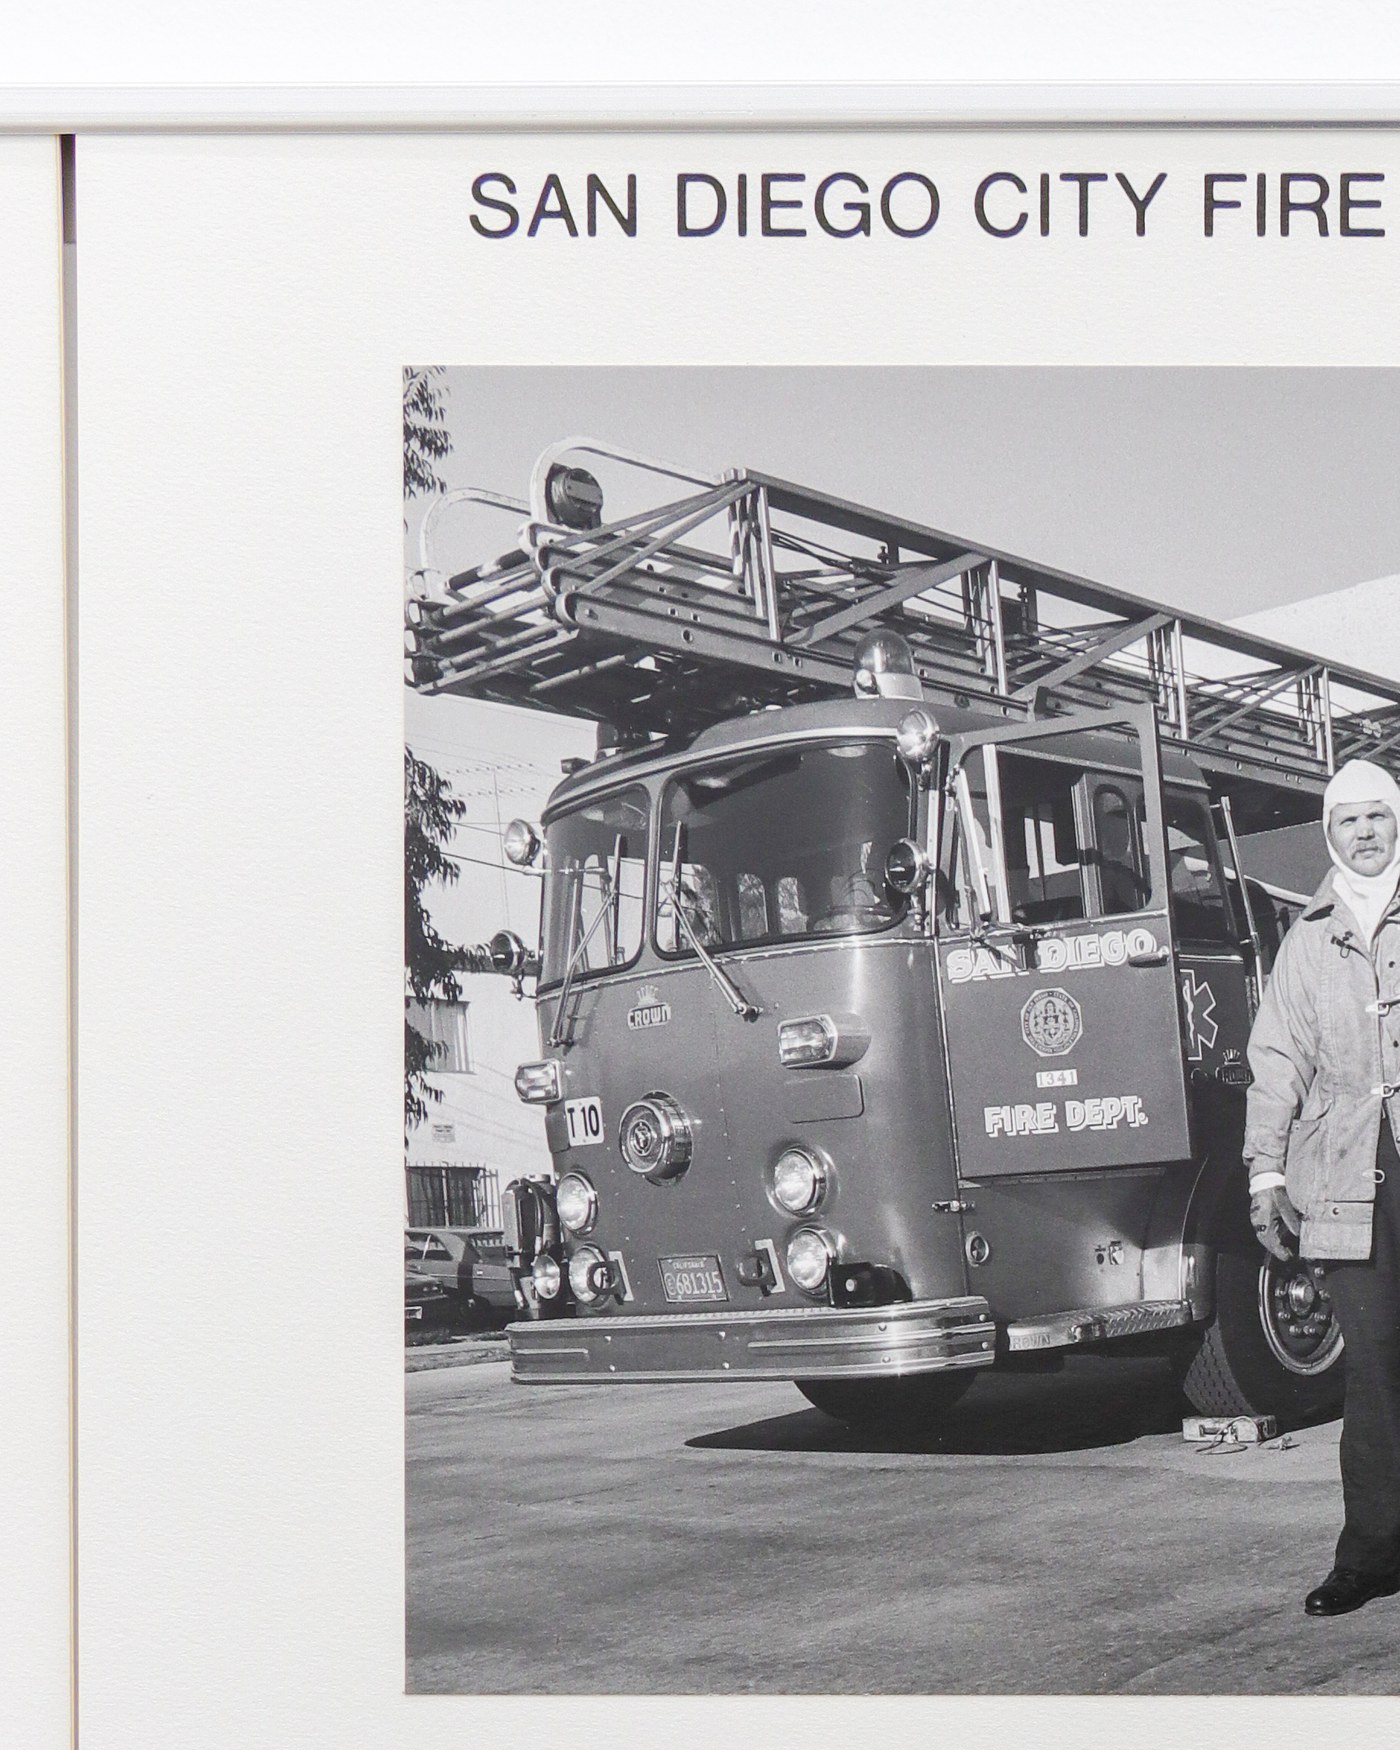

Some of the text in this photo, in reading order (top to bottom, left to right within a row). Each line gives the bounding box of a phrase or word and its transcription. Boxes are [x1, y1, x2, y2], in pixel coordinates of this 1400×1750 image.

[470, 173, 636, 238] SAN
[678, 172, 939, 238] DIEGO
[975, 173, 1167, 238] CITY
[1204, 173, 1385, 237] FIRE
[627, 1005, 672, 1028] CROWN
[1038, 1070, 1076, 1086] 1341
[567, 1104, 600, 1139] T 10
[984, 1095, 1149, 1138] FIRE DEPT.
[676, 1270, 723, 1295] 681315
